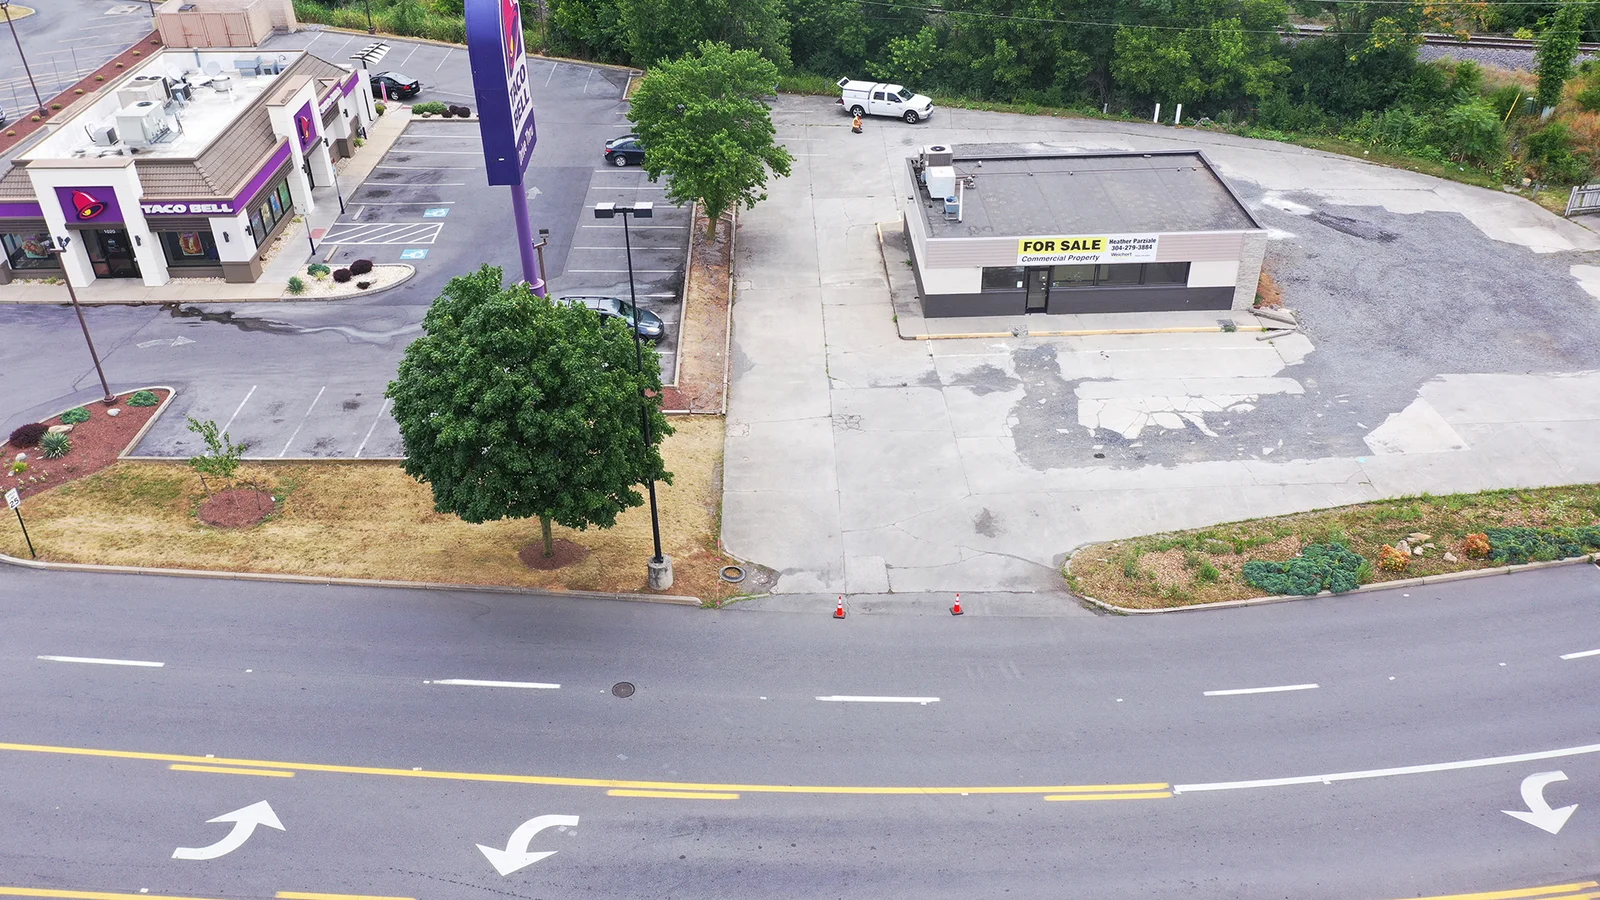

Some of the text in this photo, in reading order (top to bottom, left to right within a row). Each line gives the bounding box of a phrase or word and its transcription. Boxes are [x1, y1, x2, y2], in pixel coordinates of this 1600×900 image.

[510, 64, 526, 107] TACO
[514, 88, 530, 130] BELL
[141, 203, 233, 213] TACO BELL
[1023, 239, 1101, 252] FOR SALE
[1021, 254, 1100, 263] Commercial Property
[9, 497, 20, 508] 25
